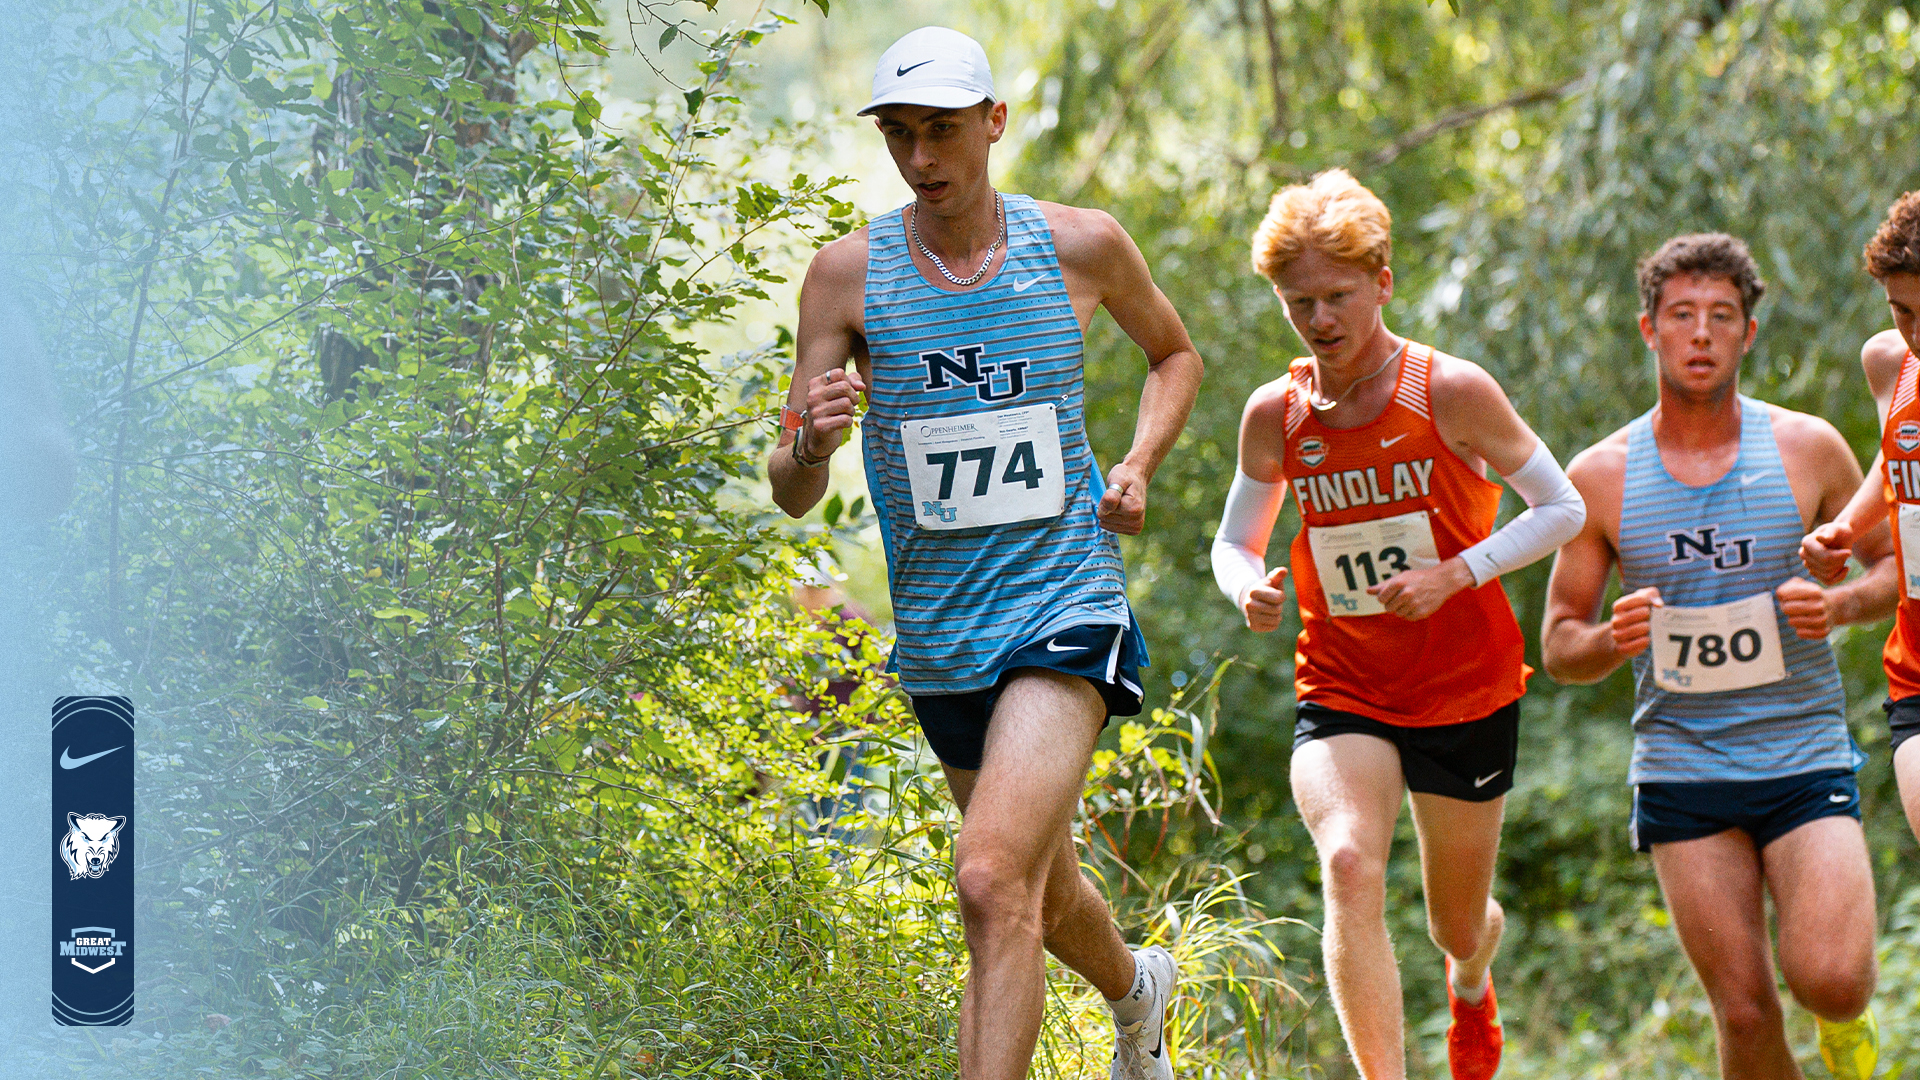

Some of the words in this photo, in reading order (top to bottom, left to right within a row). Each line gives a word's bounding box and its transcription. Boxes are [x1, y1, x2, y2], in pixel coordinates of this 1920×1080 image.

[919, 343, 1030, 404] NU
[920, 423, 978, 438] OPPENHEIMER
[925, 441, 1044, 500] 774
[1292, 457, 1434, 516] FINDLAY
[922, 501, 958, 522] NU
[1335, 546, 1411, 591] 113
[1667, 524, 1756, 573] NU
[1668, 628, 1762, 668] 780
